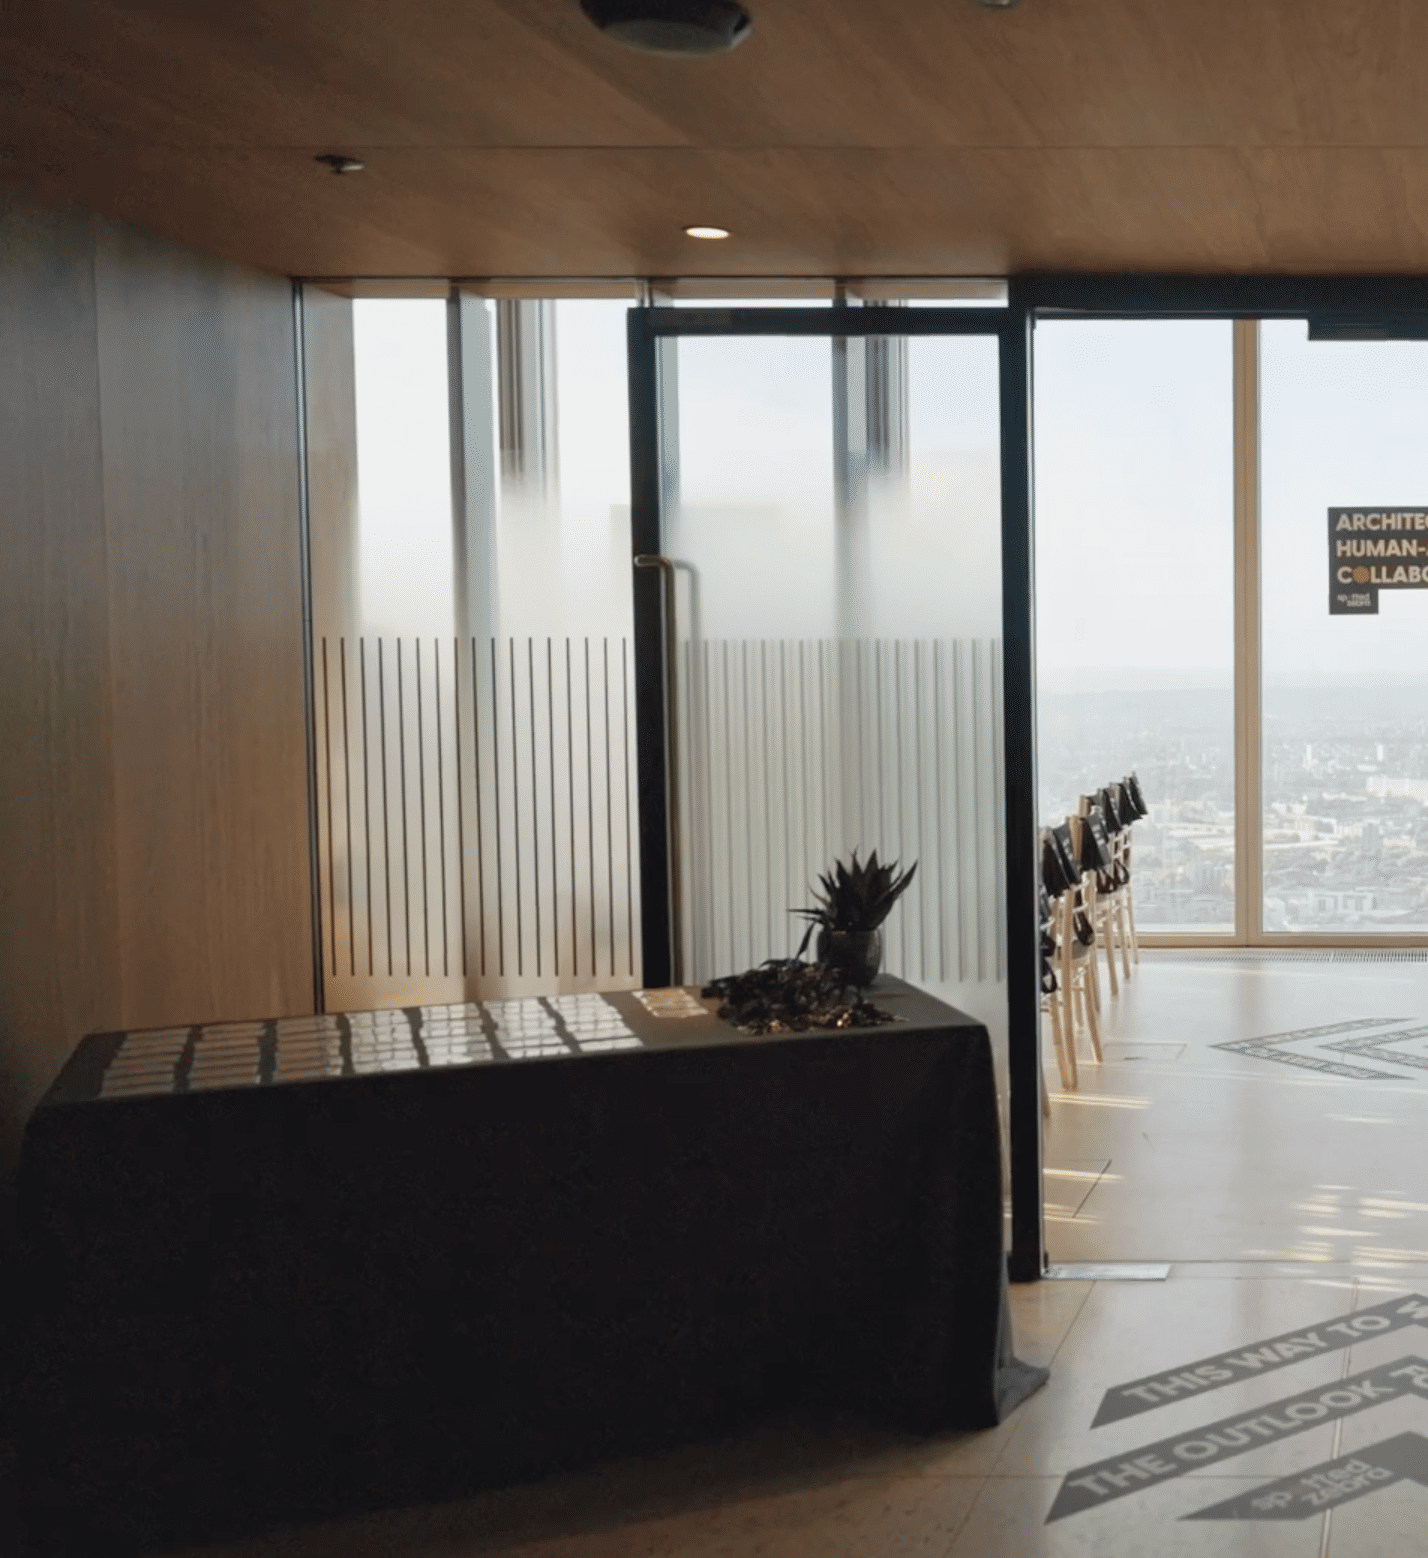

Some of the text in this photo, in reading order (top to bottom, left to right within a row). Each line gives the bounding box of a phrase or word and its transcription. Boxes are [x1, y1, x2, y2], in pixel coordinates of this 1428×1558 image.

[1120, 1364, 1234, 1402] THIS
[1223, 1331, 1329, 1369] WAY
[1325, 1314, 1392, 1338] TO
[1066, 1453, 1179, 1496] THE
[1172, 1379, 1397, 1461] OUTLOOK
